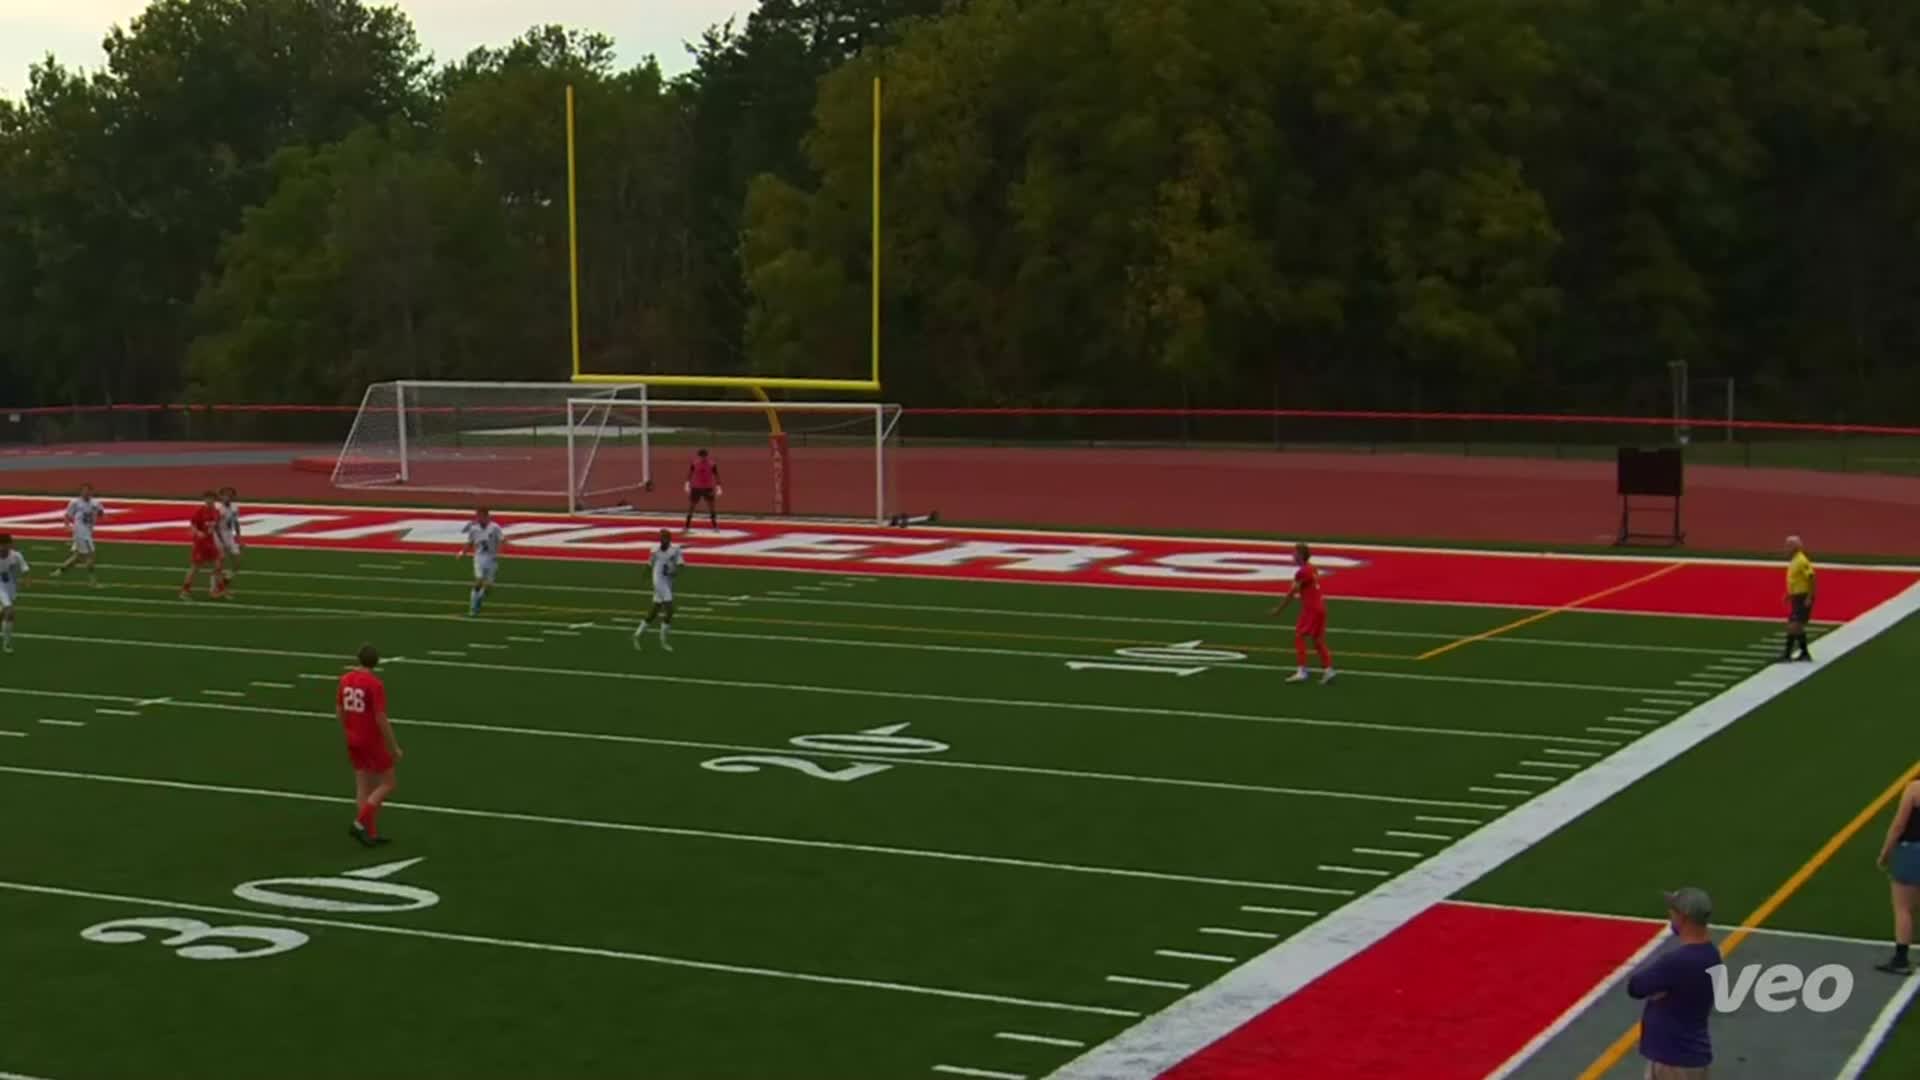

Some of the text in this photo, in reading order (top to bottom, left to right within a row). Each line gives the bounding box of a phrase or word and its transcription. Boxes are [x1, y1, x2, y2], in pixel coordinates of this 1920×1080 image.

[1065, 646, 1248, 676] 10
[343, 686, 366, 713] 26
[700, 734, 950, 781] 20
[80, 877, 440, 960] 30
